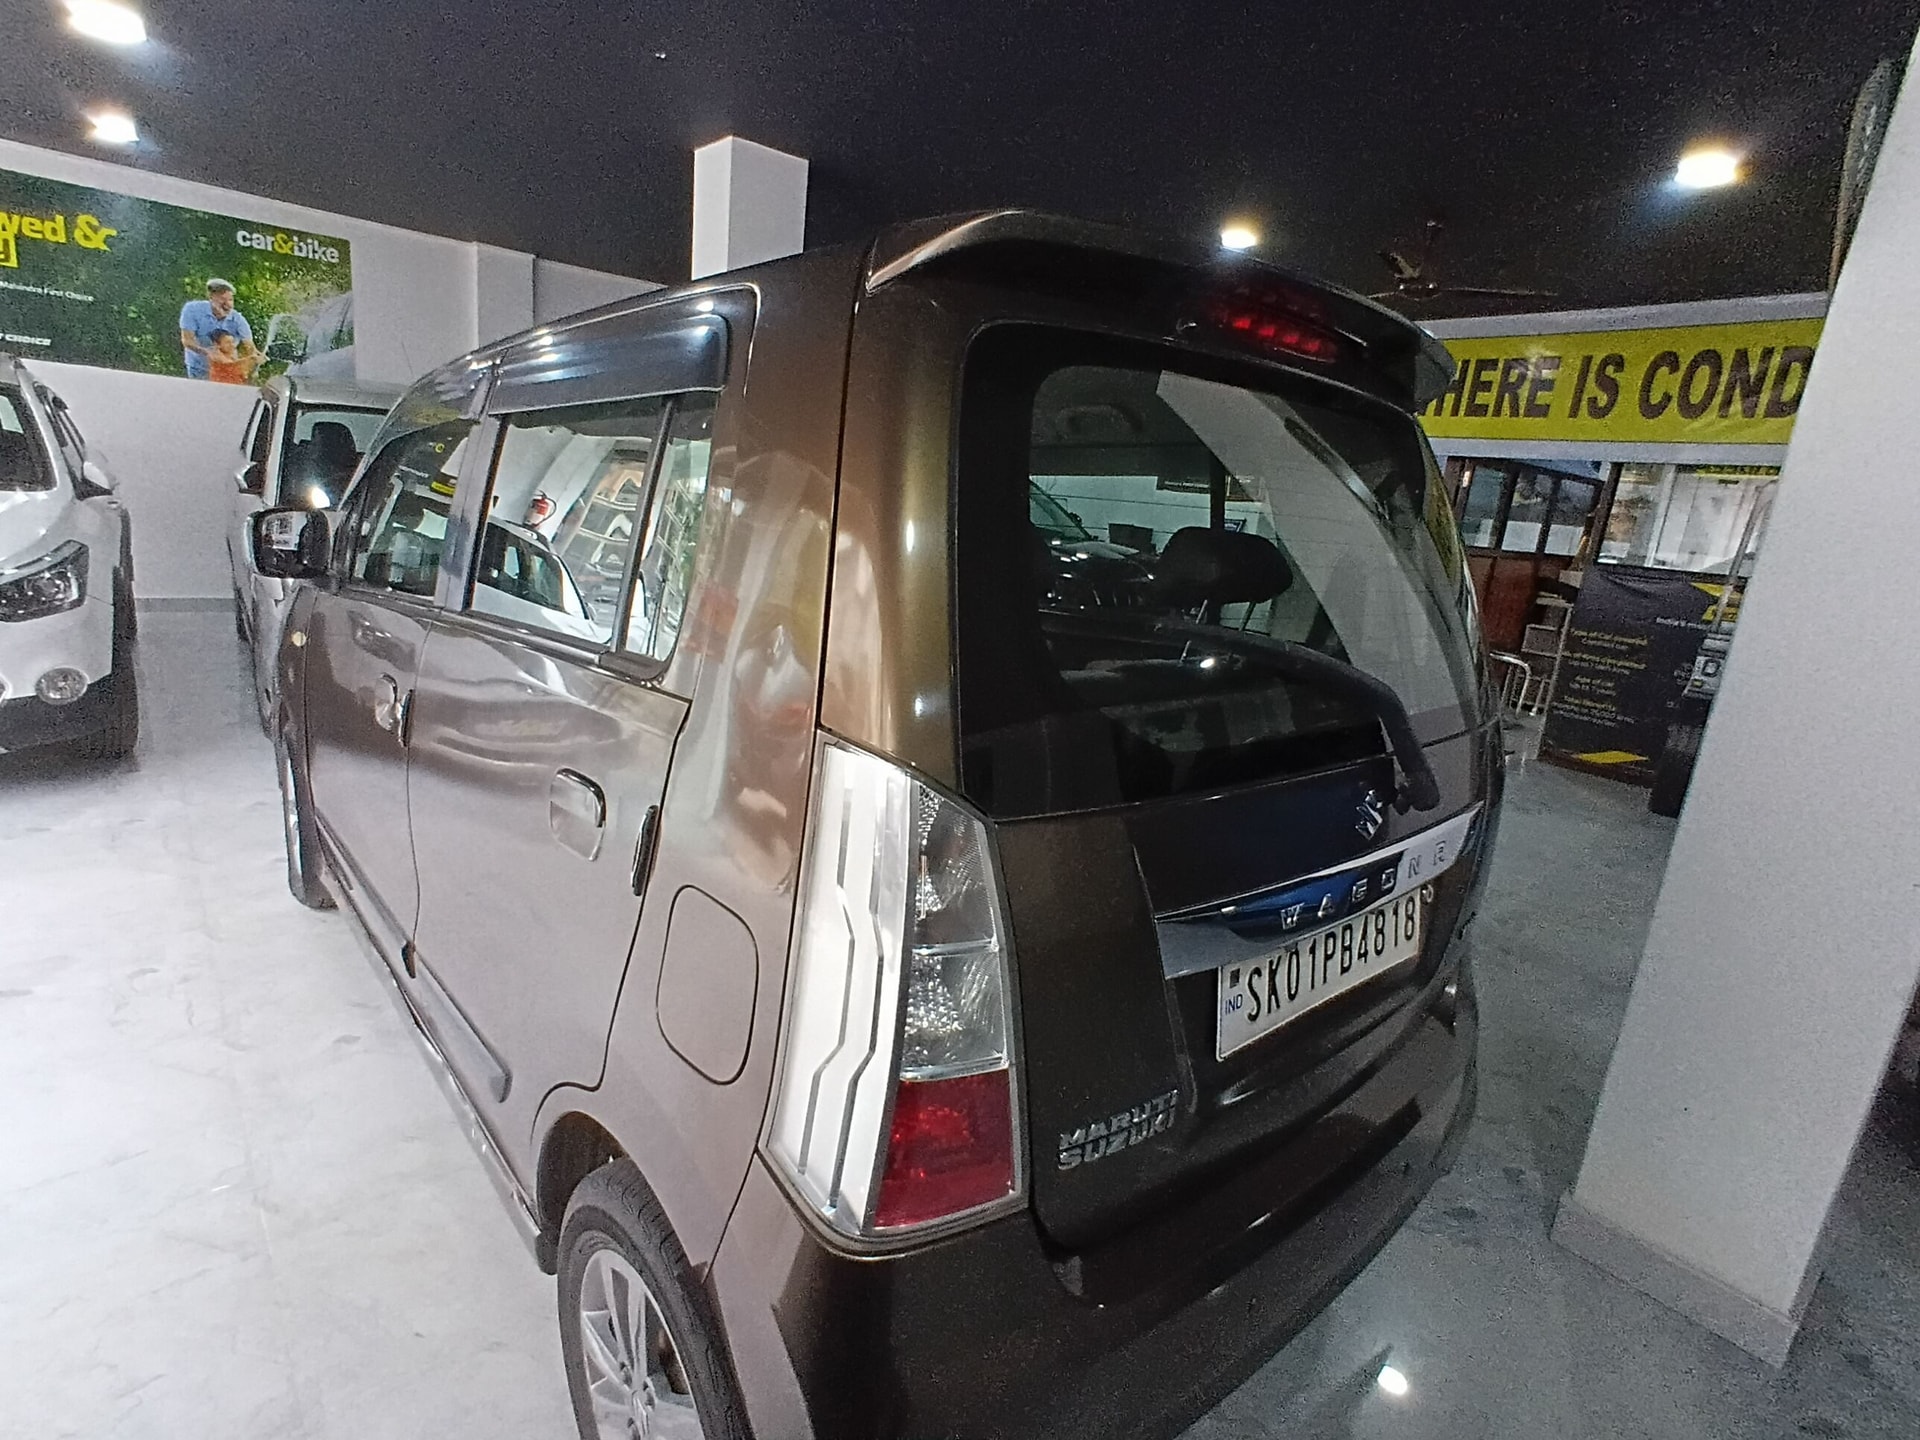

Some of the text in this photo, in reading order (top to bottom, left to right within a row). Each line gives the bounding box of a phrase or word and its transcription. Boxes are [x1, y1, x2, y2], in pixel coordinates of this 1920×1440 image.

[74, 214, 117, 252] &
[236, 230, 339, 263] car&bike
[1417, 345, 1815, 420] HERE IS COND
[1246, 895, 1415, 1022] SK01PB4818
[1225, 994, 1243, 1015] IND
[1058, 1107, 1176, 1170] SUZUKI
[1059, 1089, 1178, 1150] MARUTI
